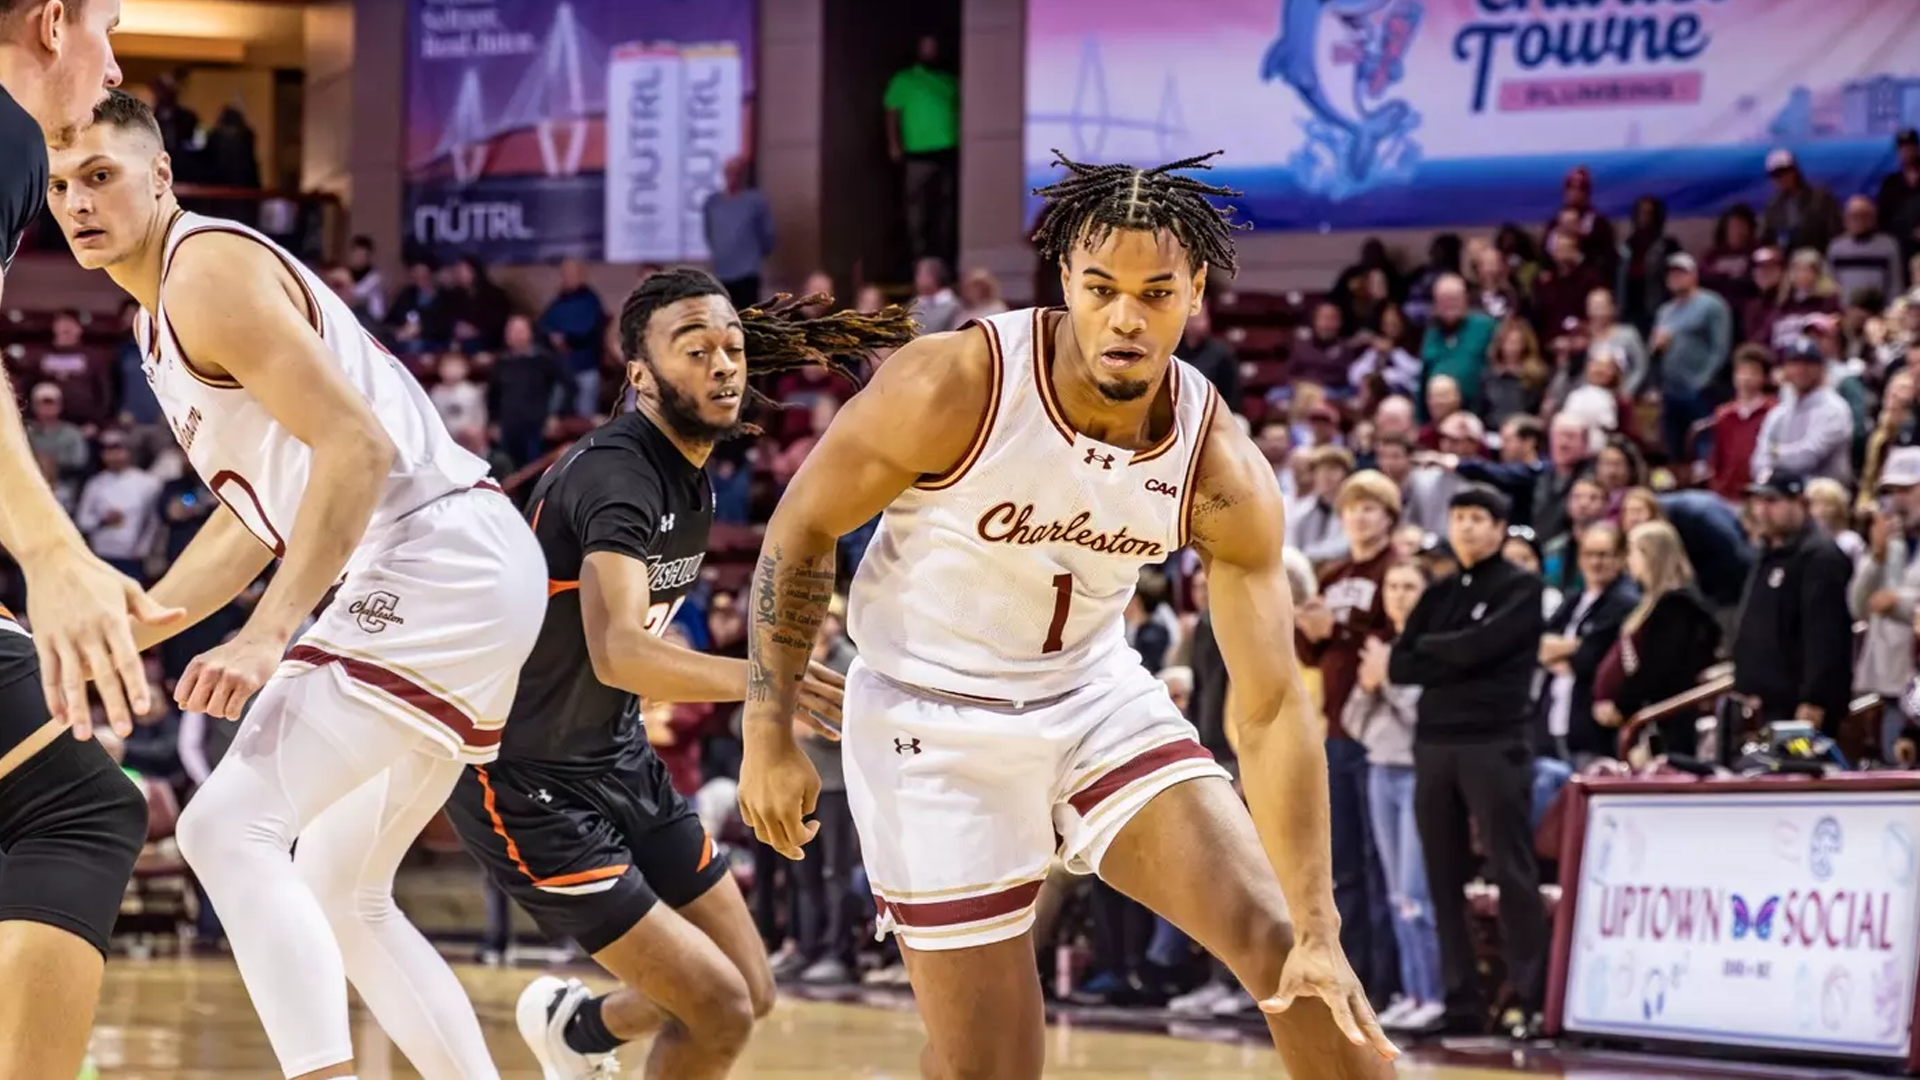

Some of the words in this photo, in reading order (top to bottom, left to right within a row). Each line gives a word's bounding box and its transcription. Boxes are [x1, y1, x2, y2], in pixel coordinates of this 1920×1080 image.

[1453, 13, 1711, 113] Towne
[1144, 478, 1179, 499] CAA
[976, 501, 1164, 558] Charleston
[1042, 572, 1074, 655] 1
[1599, 885, 1723, 943] UPTOWN
[1781, 888, 1893, 951] SOCIAL
